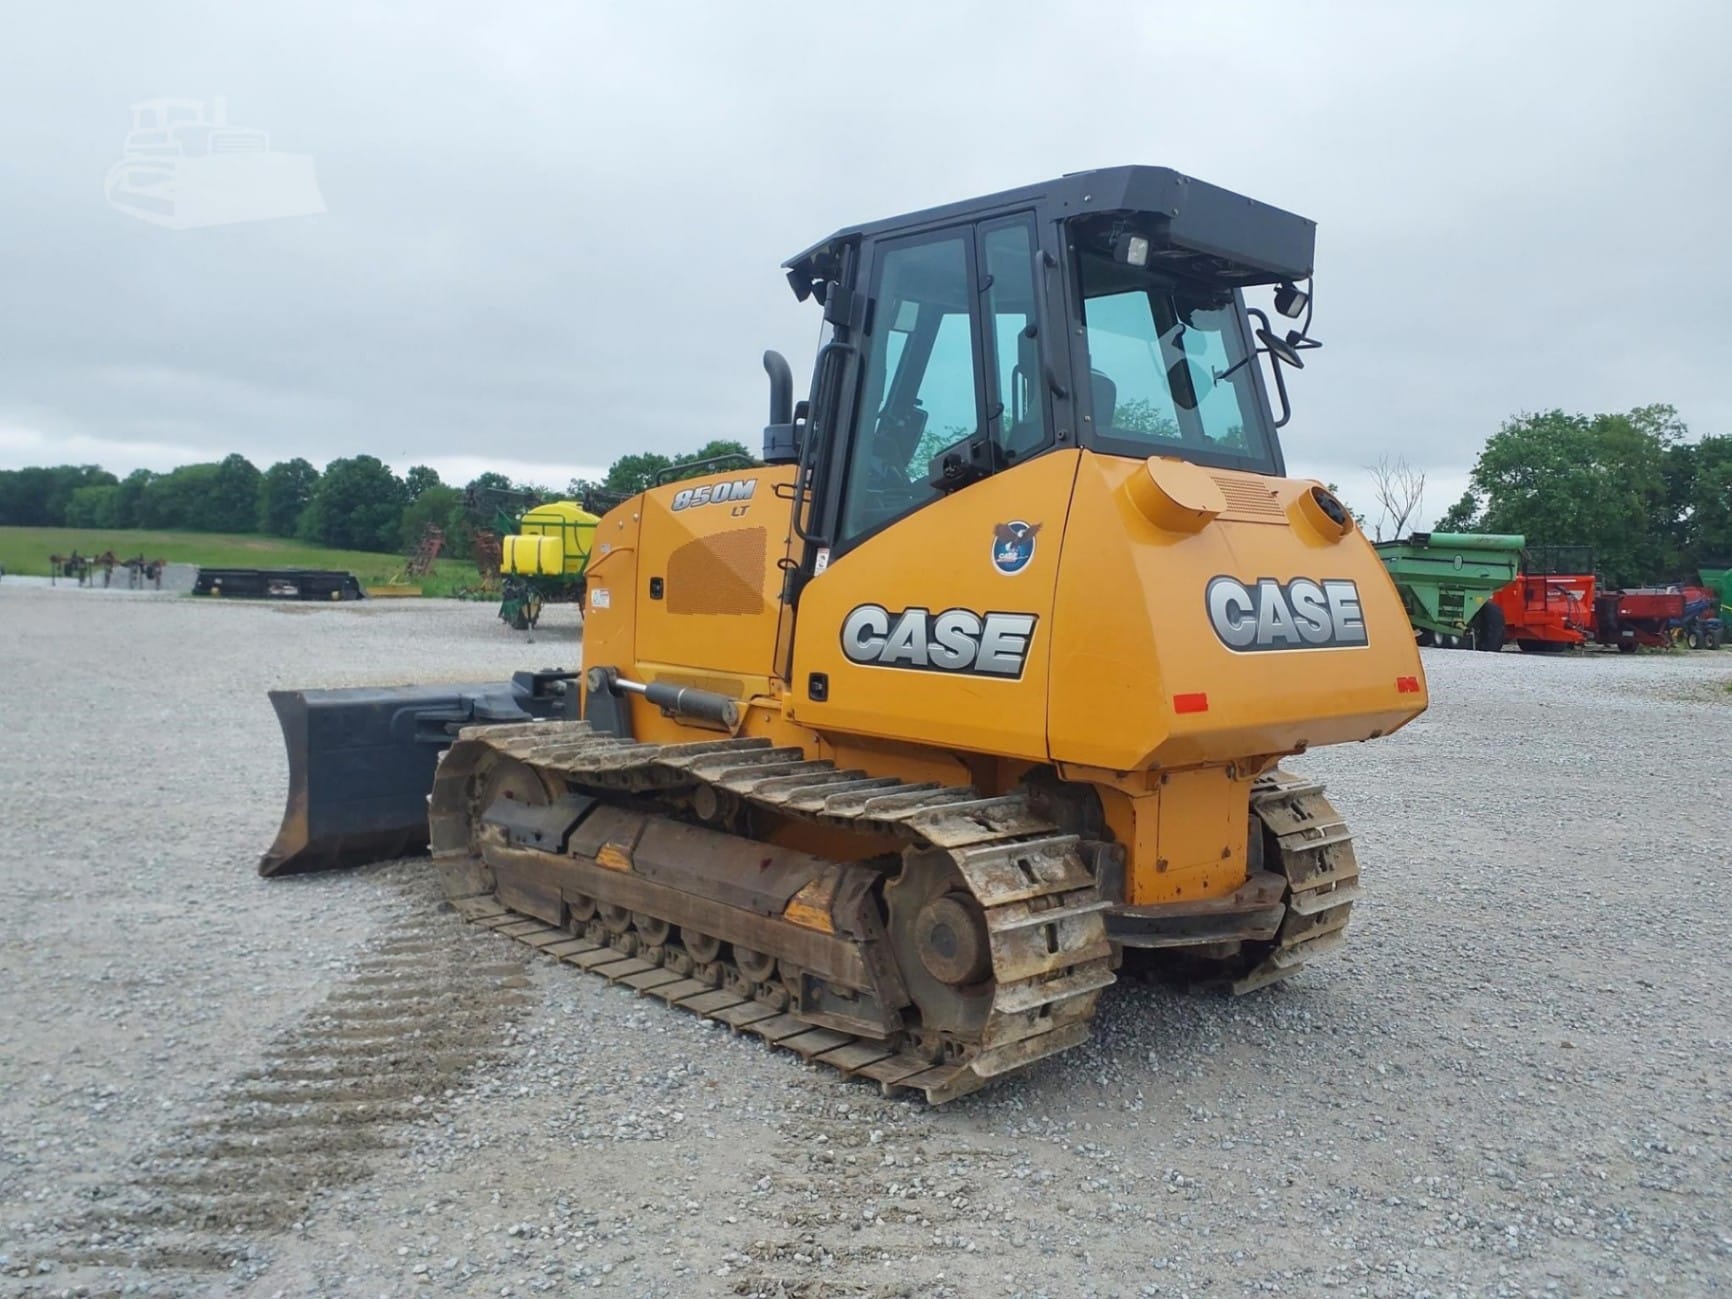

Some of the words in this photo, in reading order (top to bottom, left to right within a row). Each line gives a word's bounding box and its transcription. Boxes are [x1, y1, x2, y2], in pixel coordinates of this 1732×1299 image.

[671, 478, 758, 511] 850M
[731, 505, 751, 517] LT
[1208, 577, 1367, 646] CASE
[841, 604, 1037, 676] CASE
